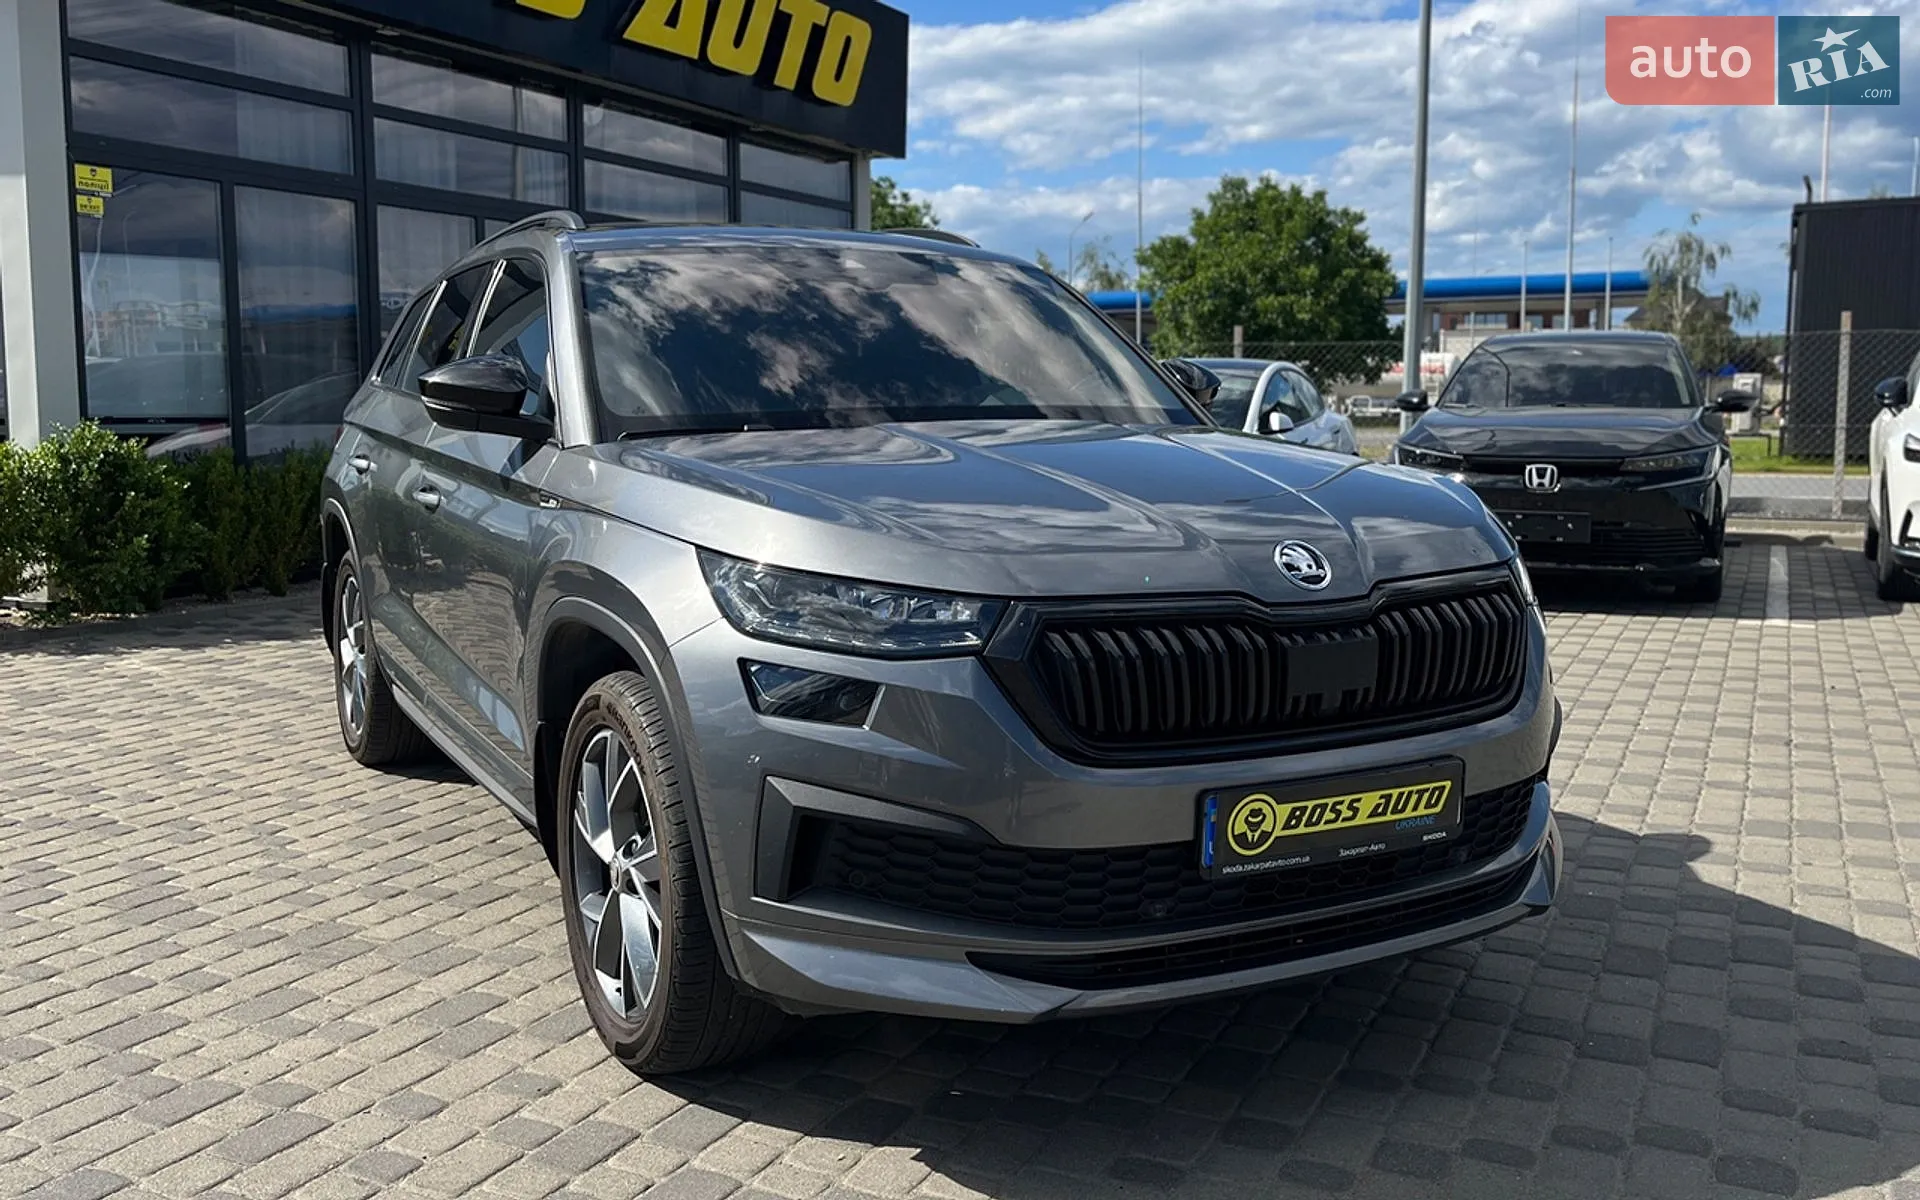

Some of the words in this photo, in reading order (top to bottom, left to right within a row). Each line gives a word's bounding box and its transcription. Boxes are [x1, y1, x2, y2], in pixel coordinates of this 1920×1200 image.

[623, 0, 872, 107] AUTO
[1281, 798, 1363, 831] BOSS
[1367, 785, 1447, 819] AUTO
